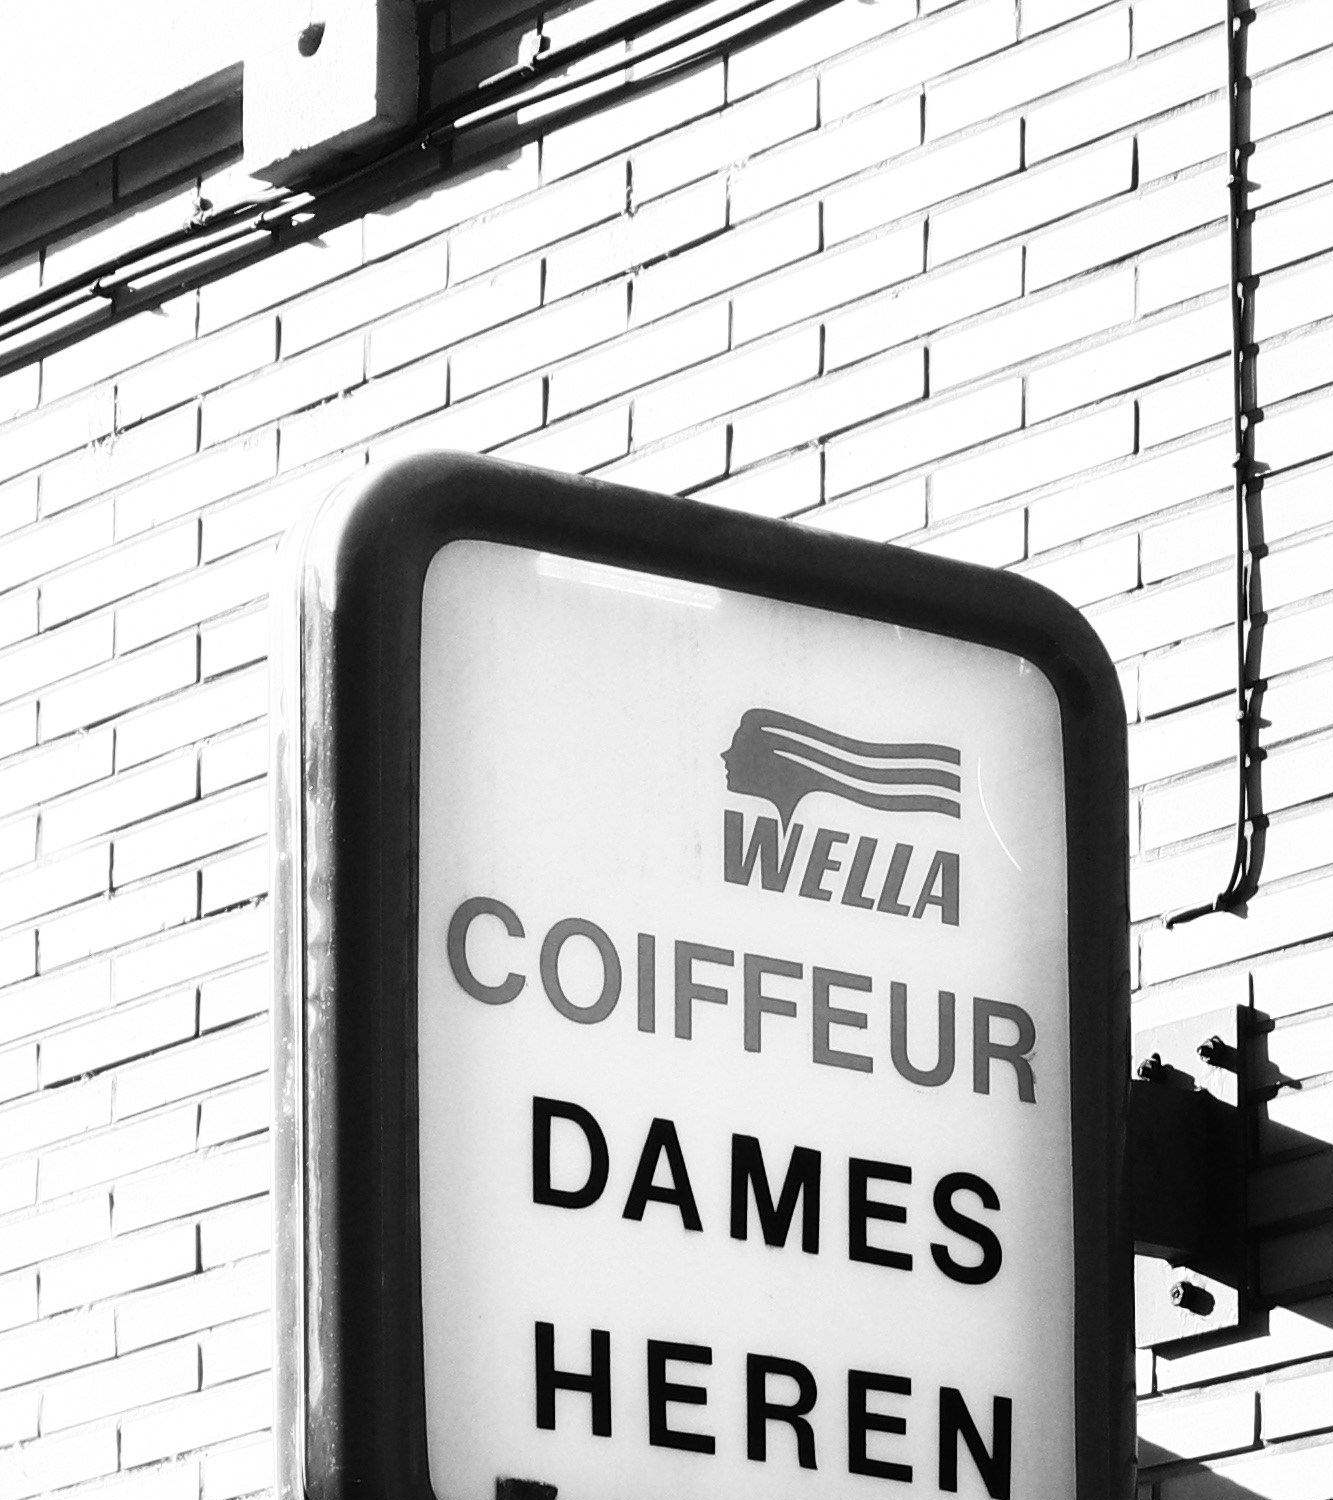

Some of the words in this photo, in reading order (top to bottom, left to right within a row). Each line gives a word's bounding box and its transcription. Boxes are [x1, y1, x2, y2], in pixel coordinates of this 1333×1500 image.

[722, 810, 961, 928] WELLA
[444, 895, 1039, 1105] COIFFEUR
[531, 1094, 1004, 1287] DAMES
